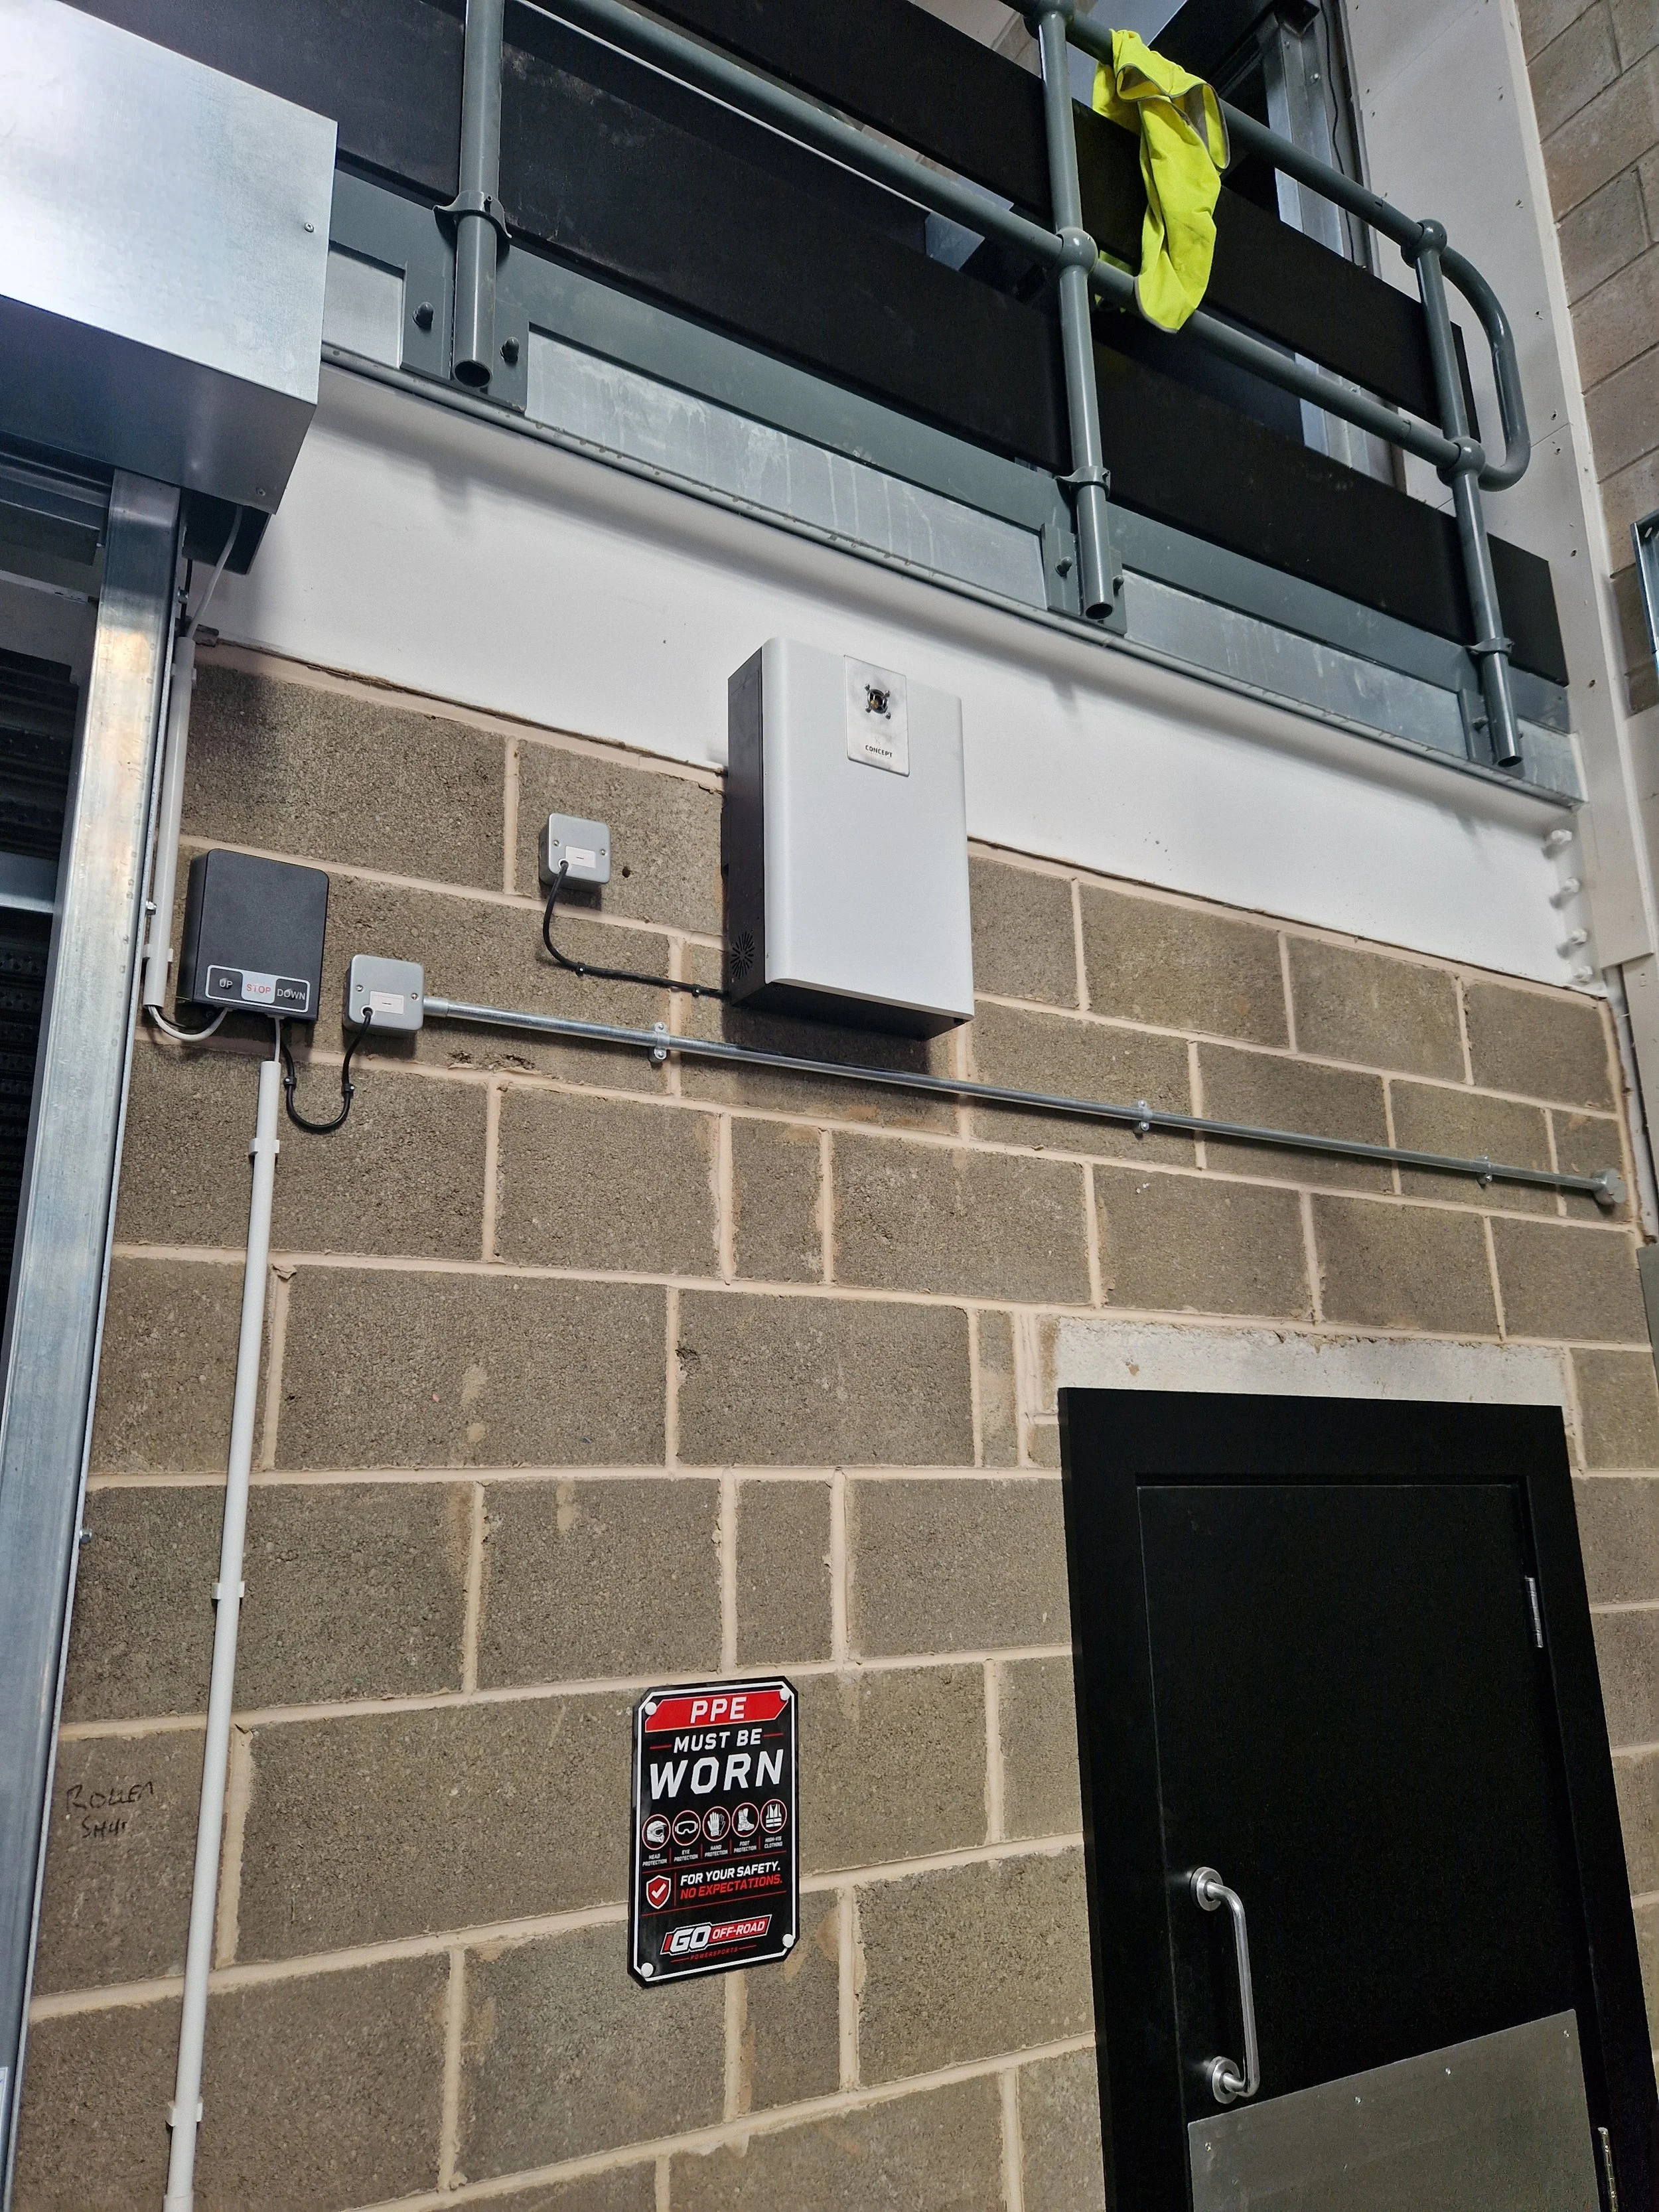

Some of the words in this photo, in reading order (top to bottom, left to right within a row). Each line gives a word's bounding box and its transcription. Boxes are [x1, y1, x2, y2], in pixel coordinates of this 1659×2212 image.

[865, 745, 893, 757] CONCEPT
[219, 978, 233, 988] UP
[246, 984, 271, 994] STOP
[277, 988, 305, 1000] DOWN
[690, 1696, 747, 1724] PPE
[673, 1732, 731, 1753] MUST
[736, 1728, 762, 1747] BE
[650, 1749, 784, 1800] WORN
[642, 1858, 668, 1867] PROTECTION
[674, 1854, 699, 1862] PROTECTION
[680, 1872, 703, 1886] FOR
[705, 1868, 735, 1882] YOUR
[737, 1860, 781, 1877] SAFETY.
[680, 1887, 696, 1899] NO
[698, 1874, 783, 1897] EXPECTATIONS.
[670, 1925, 712, 1953] GO
[712, 1921, 765, 1940] OFF-ROAD
[690, 1947, 738, 1960] POWERSPORTS
